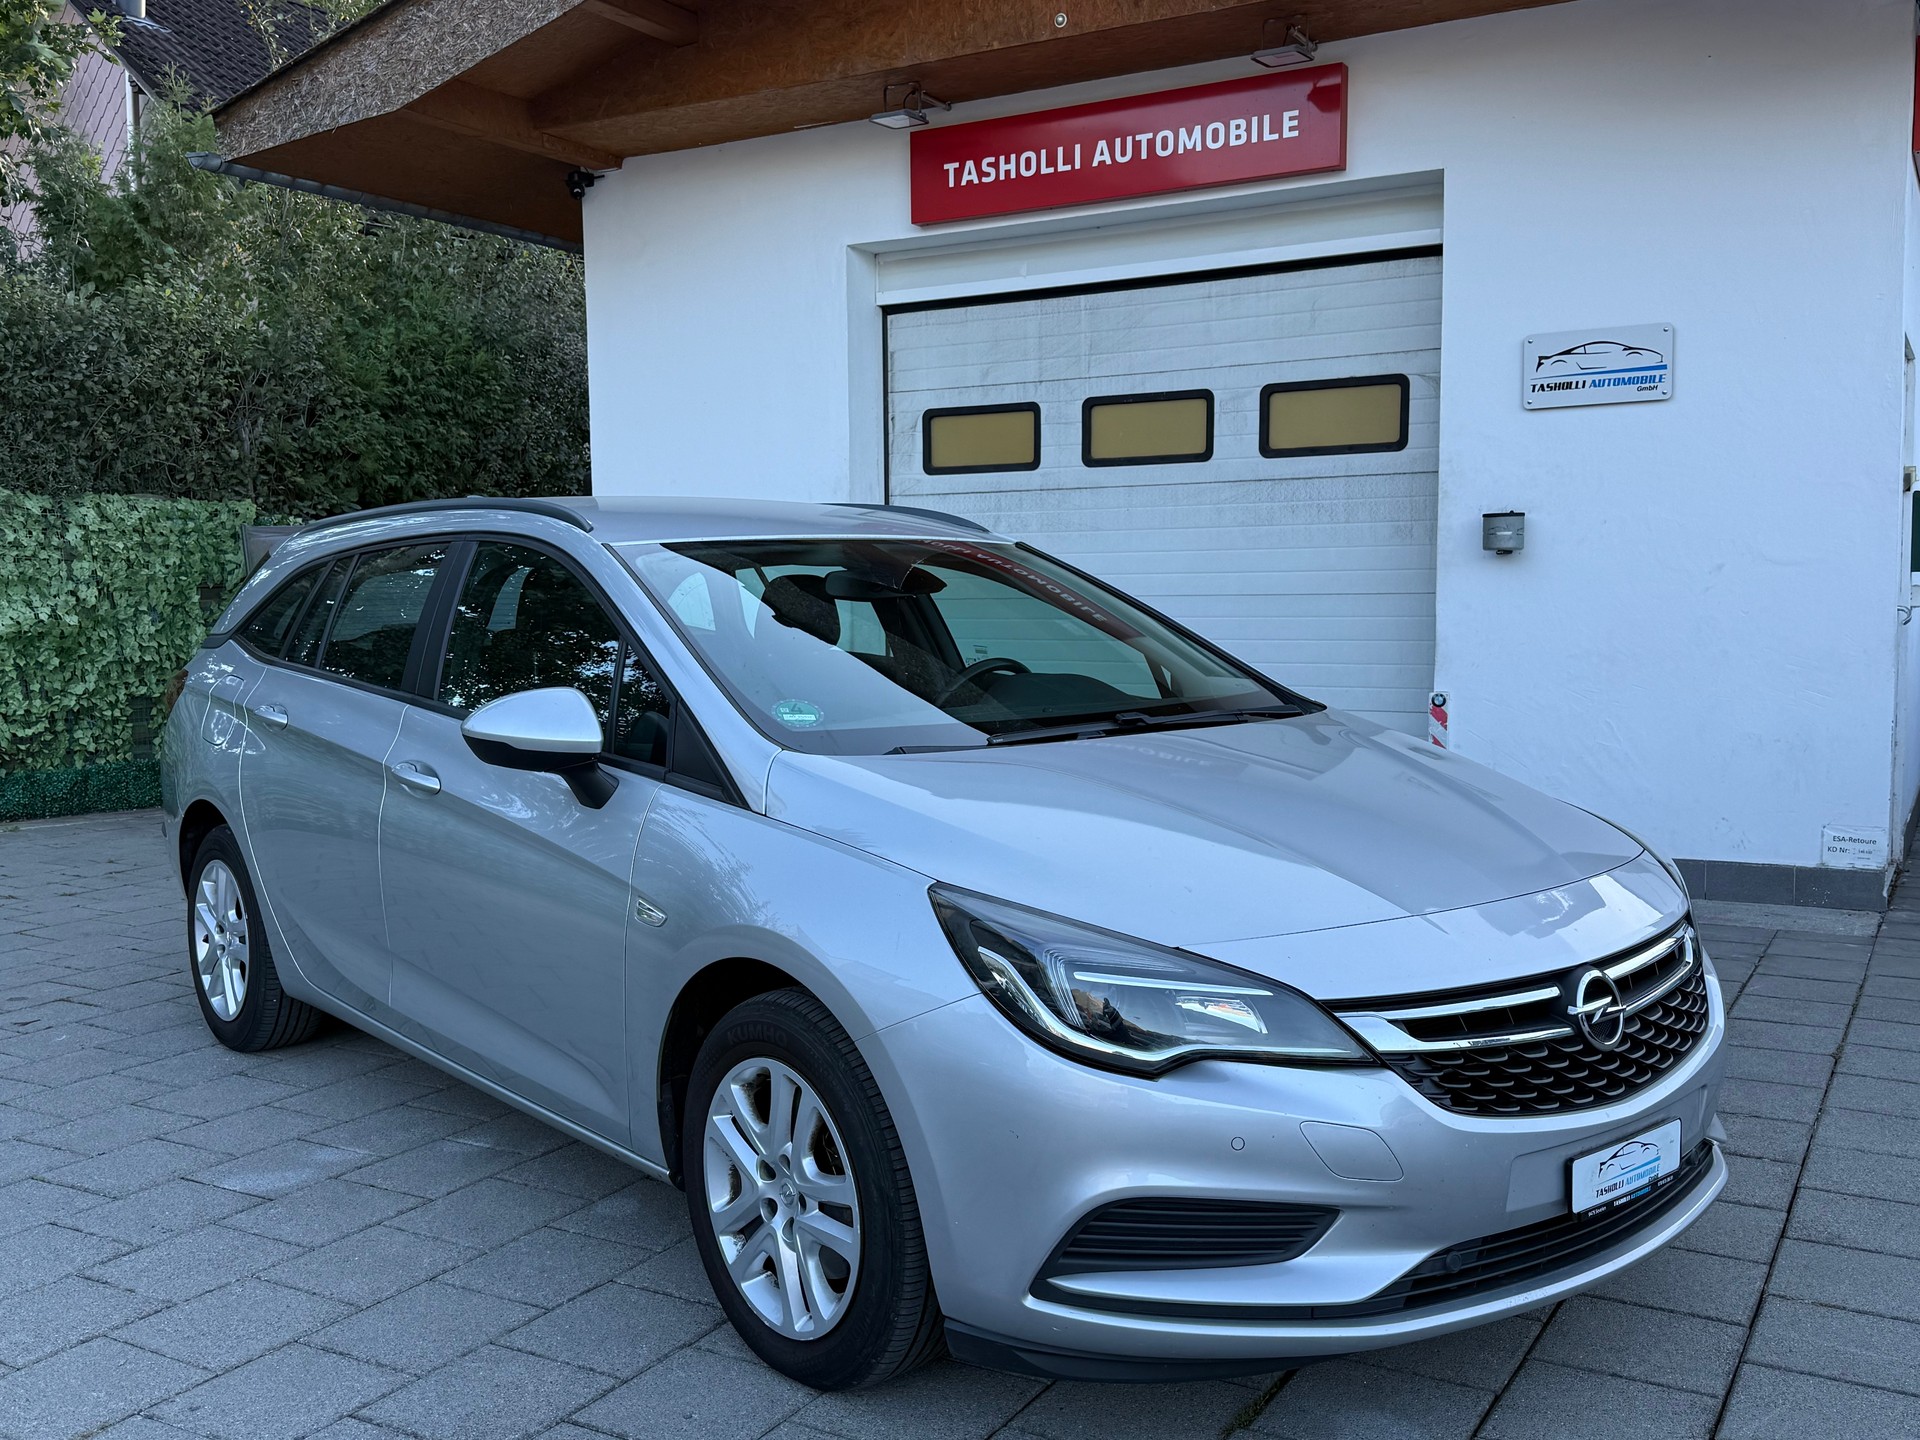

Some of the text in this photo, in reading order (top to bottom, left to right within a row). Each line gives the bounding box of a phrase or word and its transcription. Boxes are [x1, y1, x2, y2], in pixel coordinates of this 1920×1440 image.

[943, 109, 1300, 188] TASHOLLI AUTOMOBILE
[1531, 373, 1666, 393] TASHOLLI AUTOMOBILE
[1636, 384, 1659, 393] GmbH
[1833, 835, 1877, 845] ESA-Retoure
[727, 1023, 788, 1048] KUMHO
[1596, 1180, 1624, 1198] TASHOLLI
[1625, 1163, 1661, 1186] AUTOMOBILE
